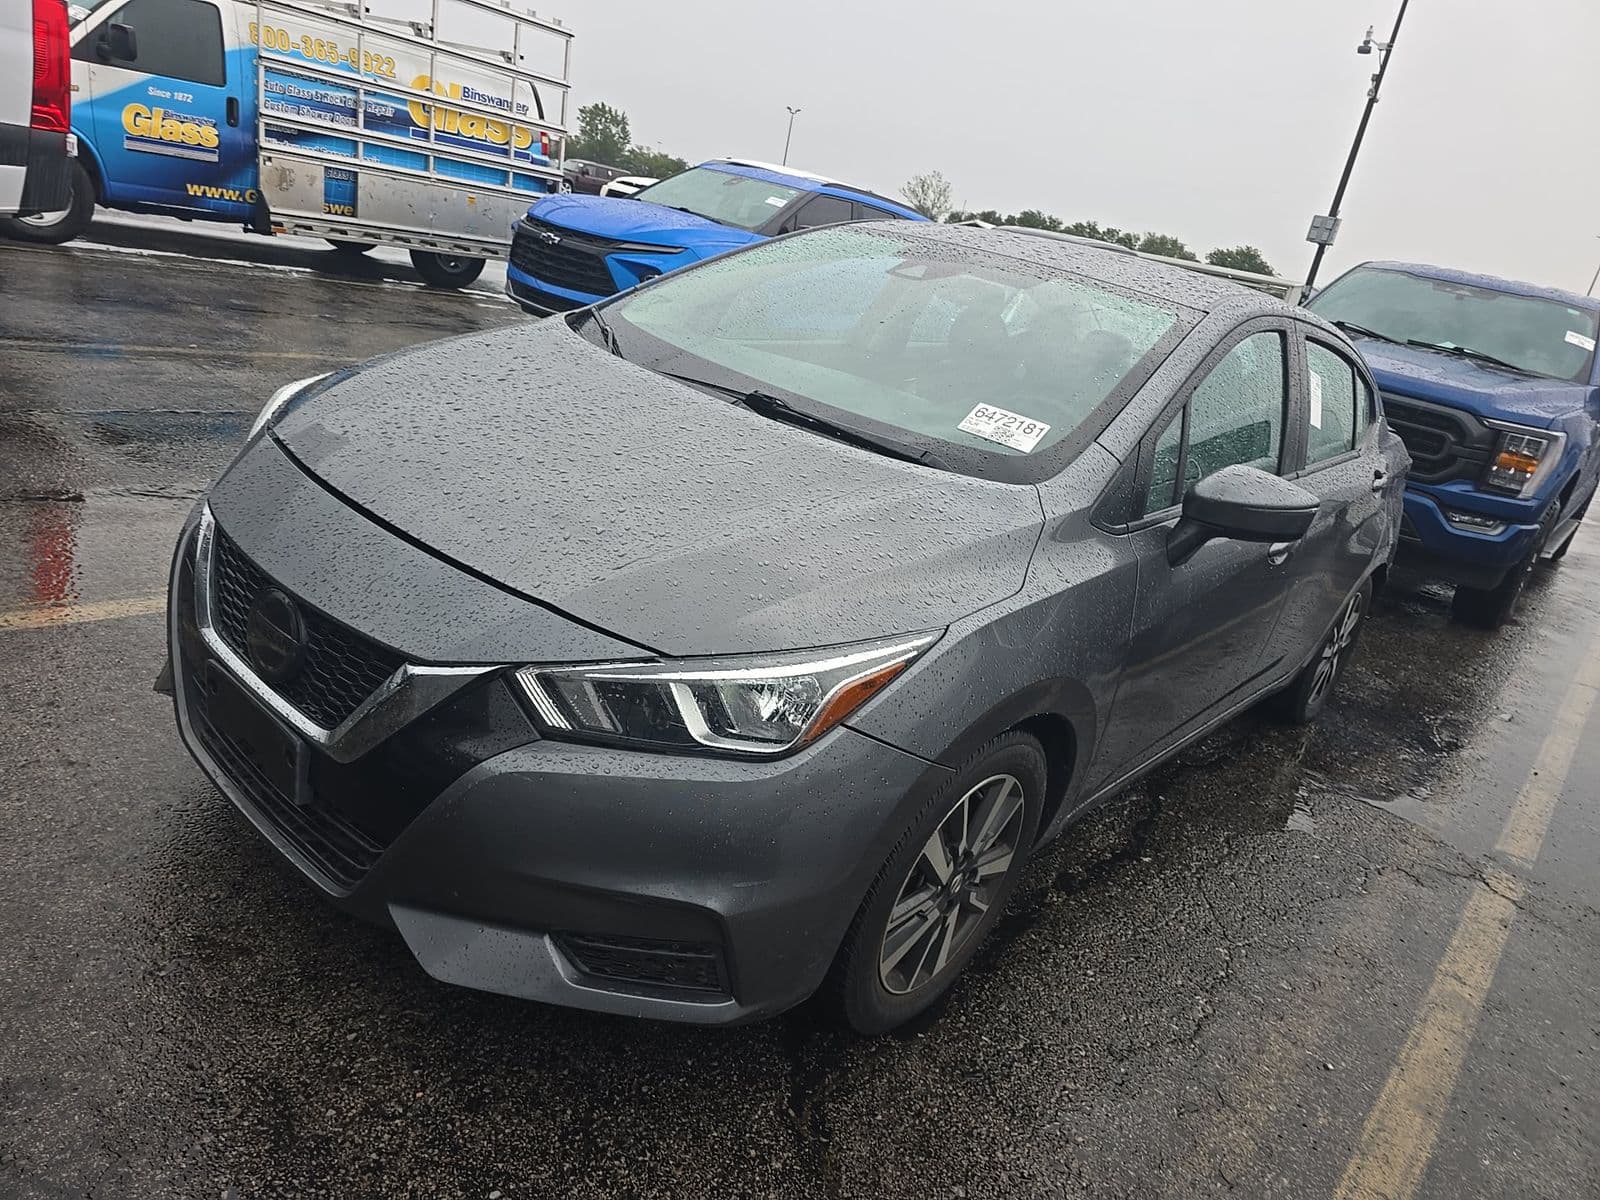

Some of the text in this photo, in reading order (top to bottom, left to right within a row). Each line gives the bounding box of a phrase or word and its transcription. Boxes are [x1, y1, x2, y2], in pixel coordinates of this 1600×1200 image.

[147, 86, 172, 98] Since
[264, 80, 285, 94] Auto
[286, 84, 313, 101] Glass
[366, 101, 395, 118] Repair
[462, 86, 529, 116] Binswaner
[122, 103, 219, 148] Glass
[264, 98, 299, 115] Custom
[300, 105, 333, 122] Shower
[408, 74, 533, 149] Glass
[974, 407, 1046, 439] 6472181
